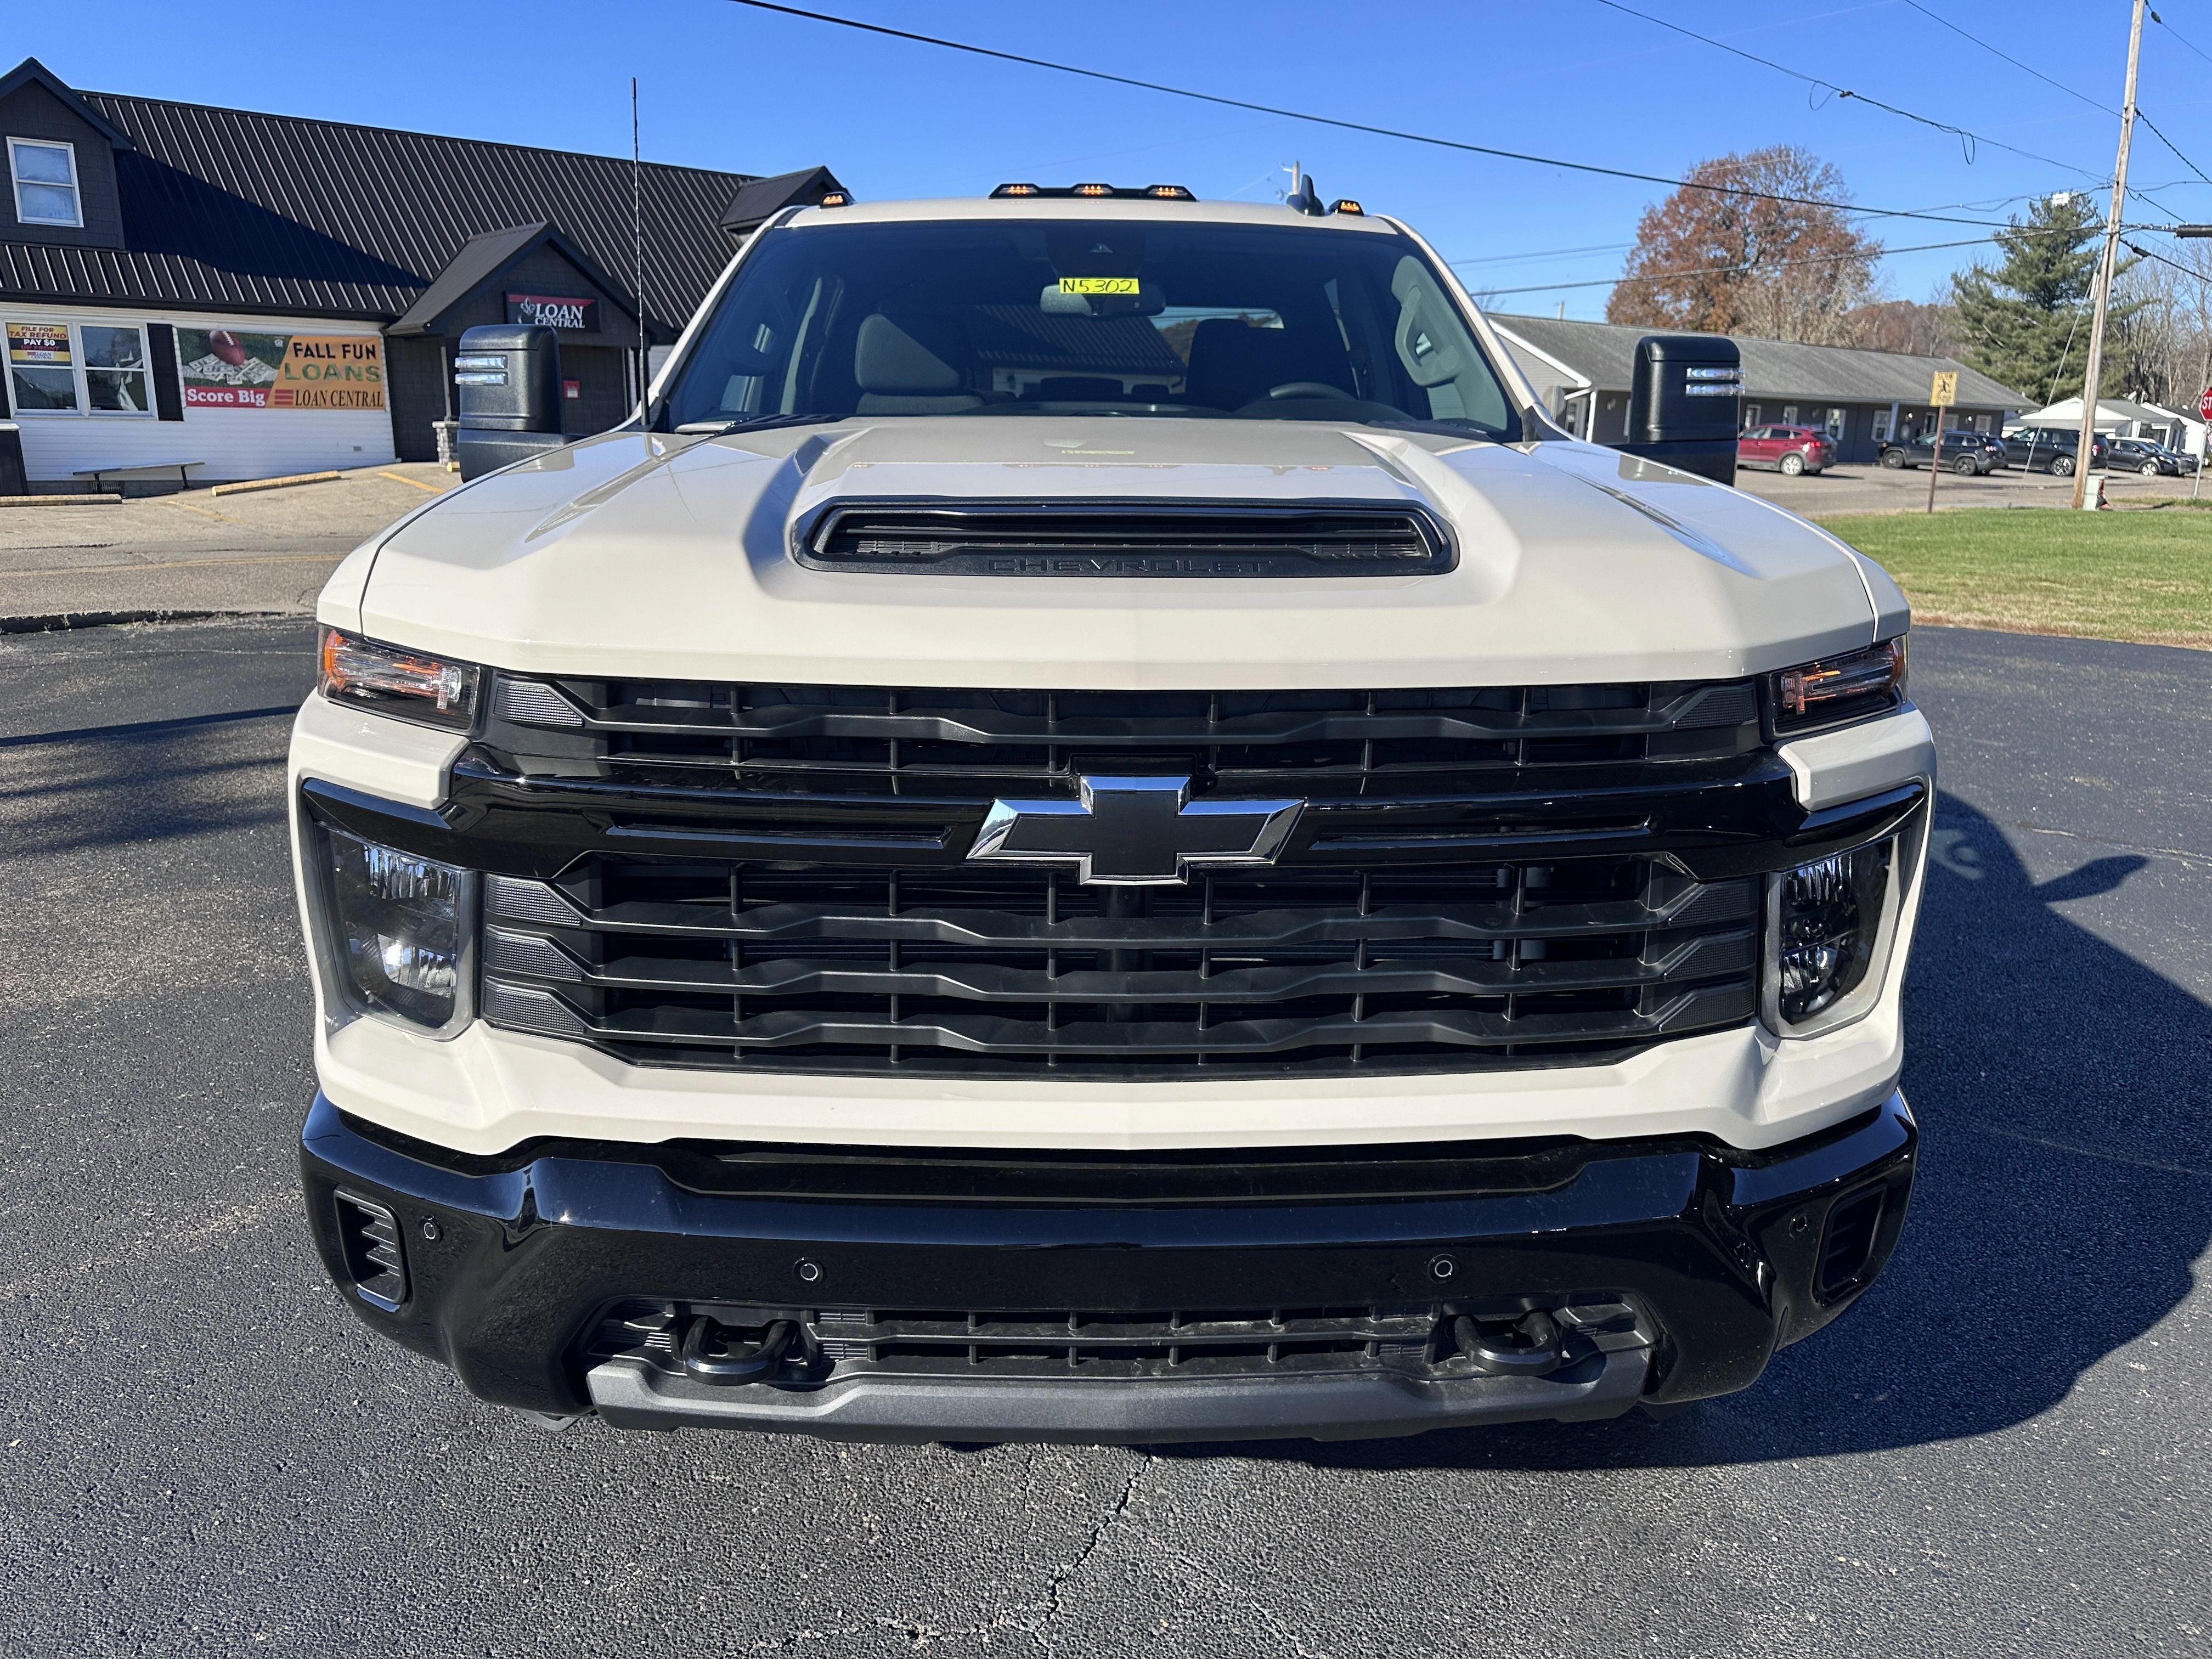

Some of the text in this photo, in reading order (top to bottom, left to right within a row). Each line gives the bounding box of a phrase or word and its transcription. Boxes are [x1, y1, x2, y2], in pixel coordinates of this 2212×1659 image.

[1063, 279, 1136, 293] N5302
[535, 303, 584, 320] LOAN
[534, 317, 585, 329] CENTRAL
[293, 342, 376, 360] FALL FUN
[284, 362, 382, 382] LOANS
[187, 388, 266, 407] Score Big
[295, 389, 383, 408] LOAN CENTRAL
[2202, 396, 2212, 410] ST
[988, 558, 1271, 572] CHEVROLET
